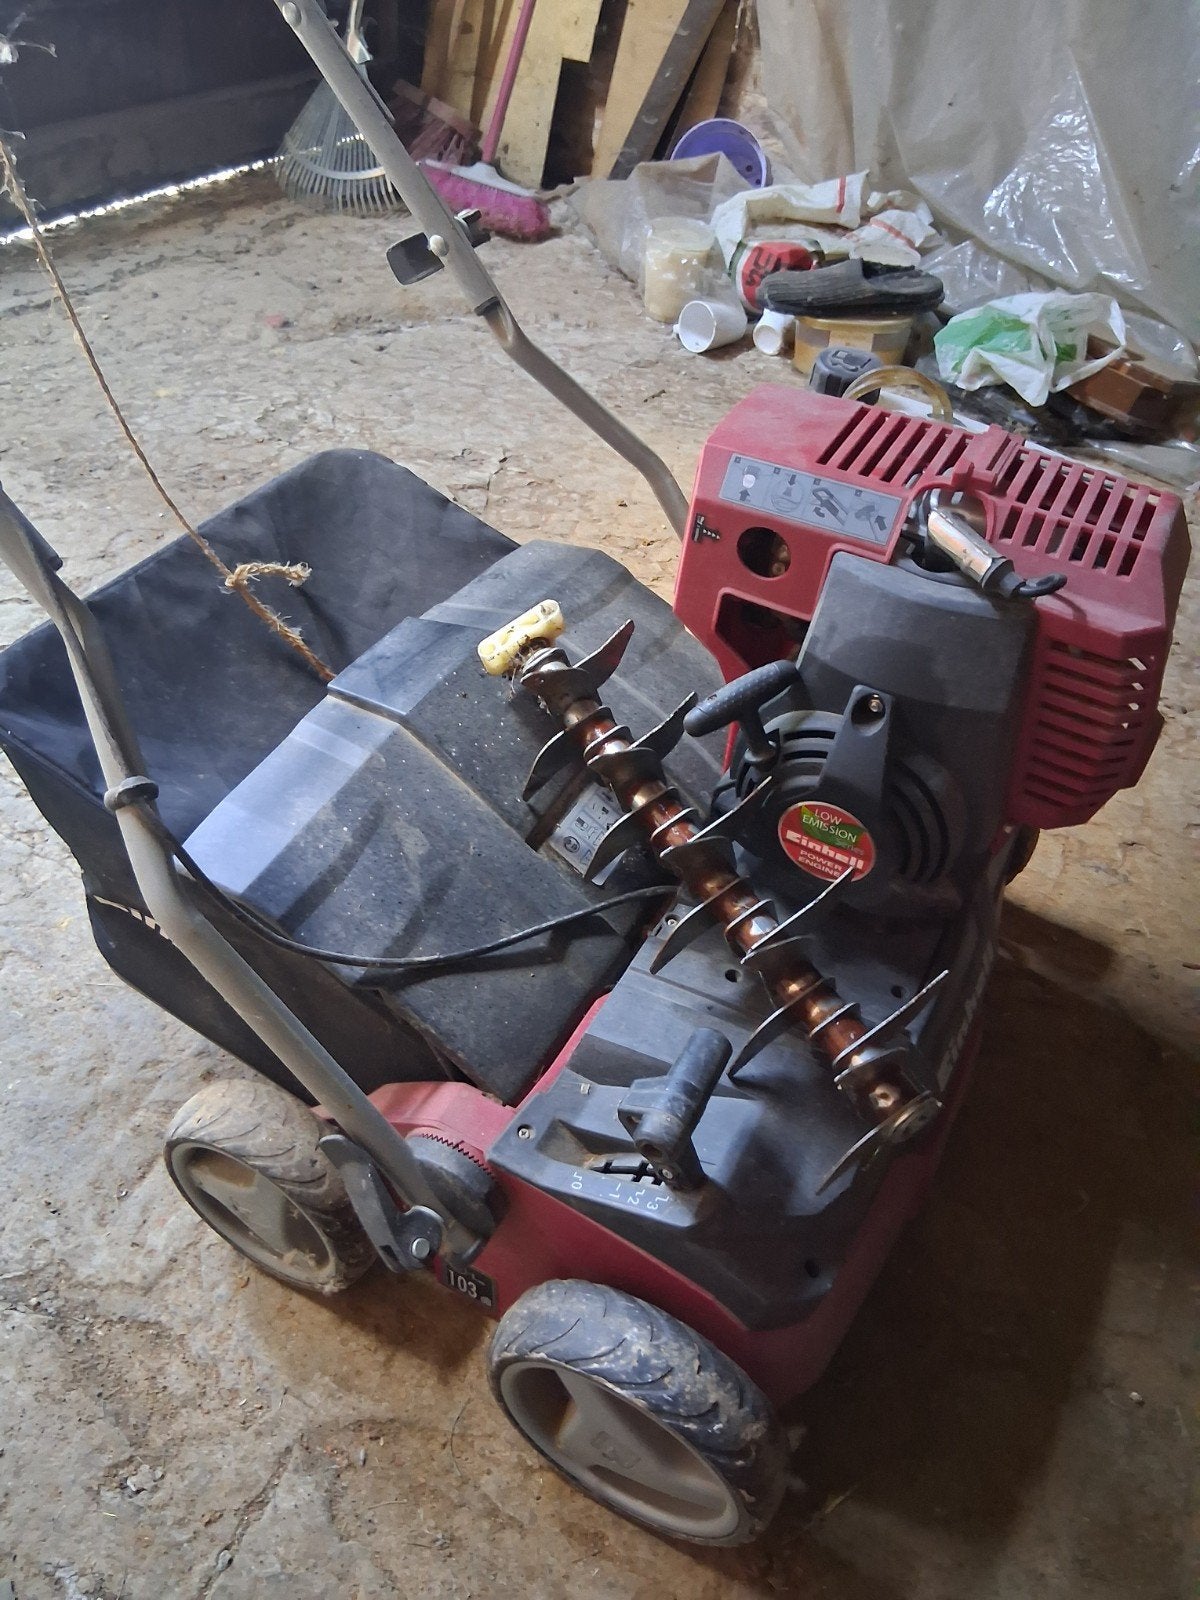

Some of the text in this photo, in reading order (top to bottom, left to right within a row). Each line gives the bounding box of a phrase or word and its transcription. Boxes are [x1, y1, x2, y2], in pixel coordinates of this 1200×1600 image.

[815, 808, 842, 825] LOW
[802, 814, 857, 843] EMISSION
[786, 829, 864, 869] Einhell
[800, 849, 843, 871] POWER
[798, 857, 841, 878] ENGINE
[628, 1196, 640, 1205] 2
[646, 1201, 659, 1210] 3
[448, 1269, 478, 1298] 103
